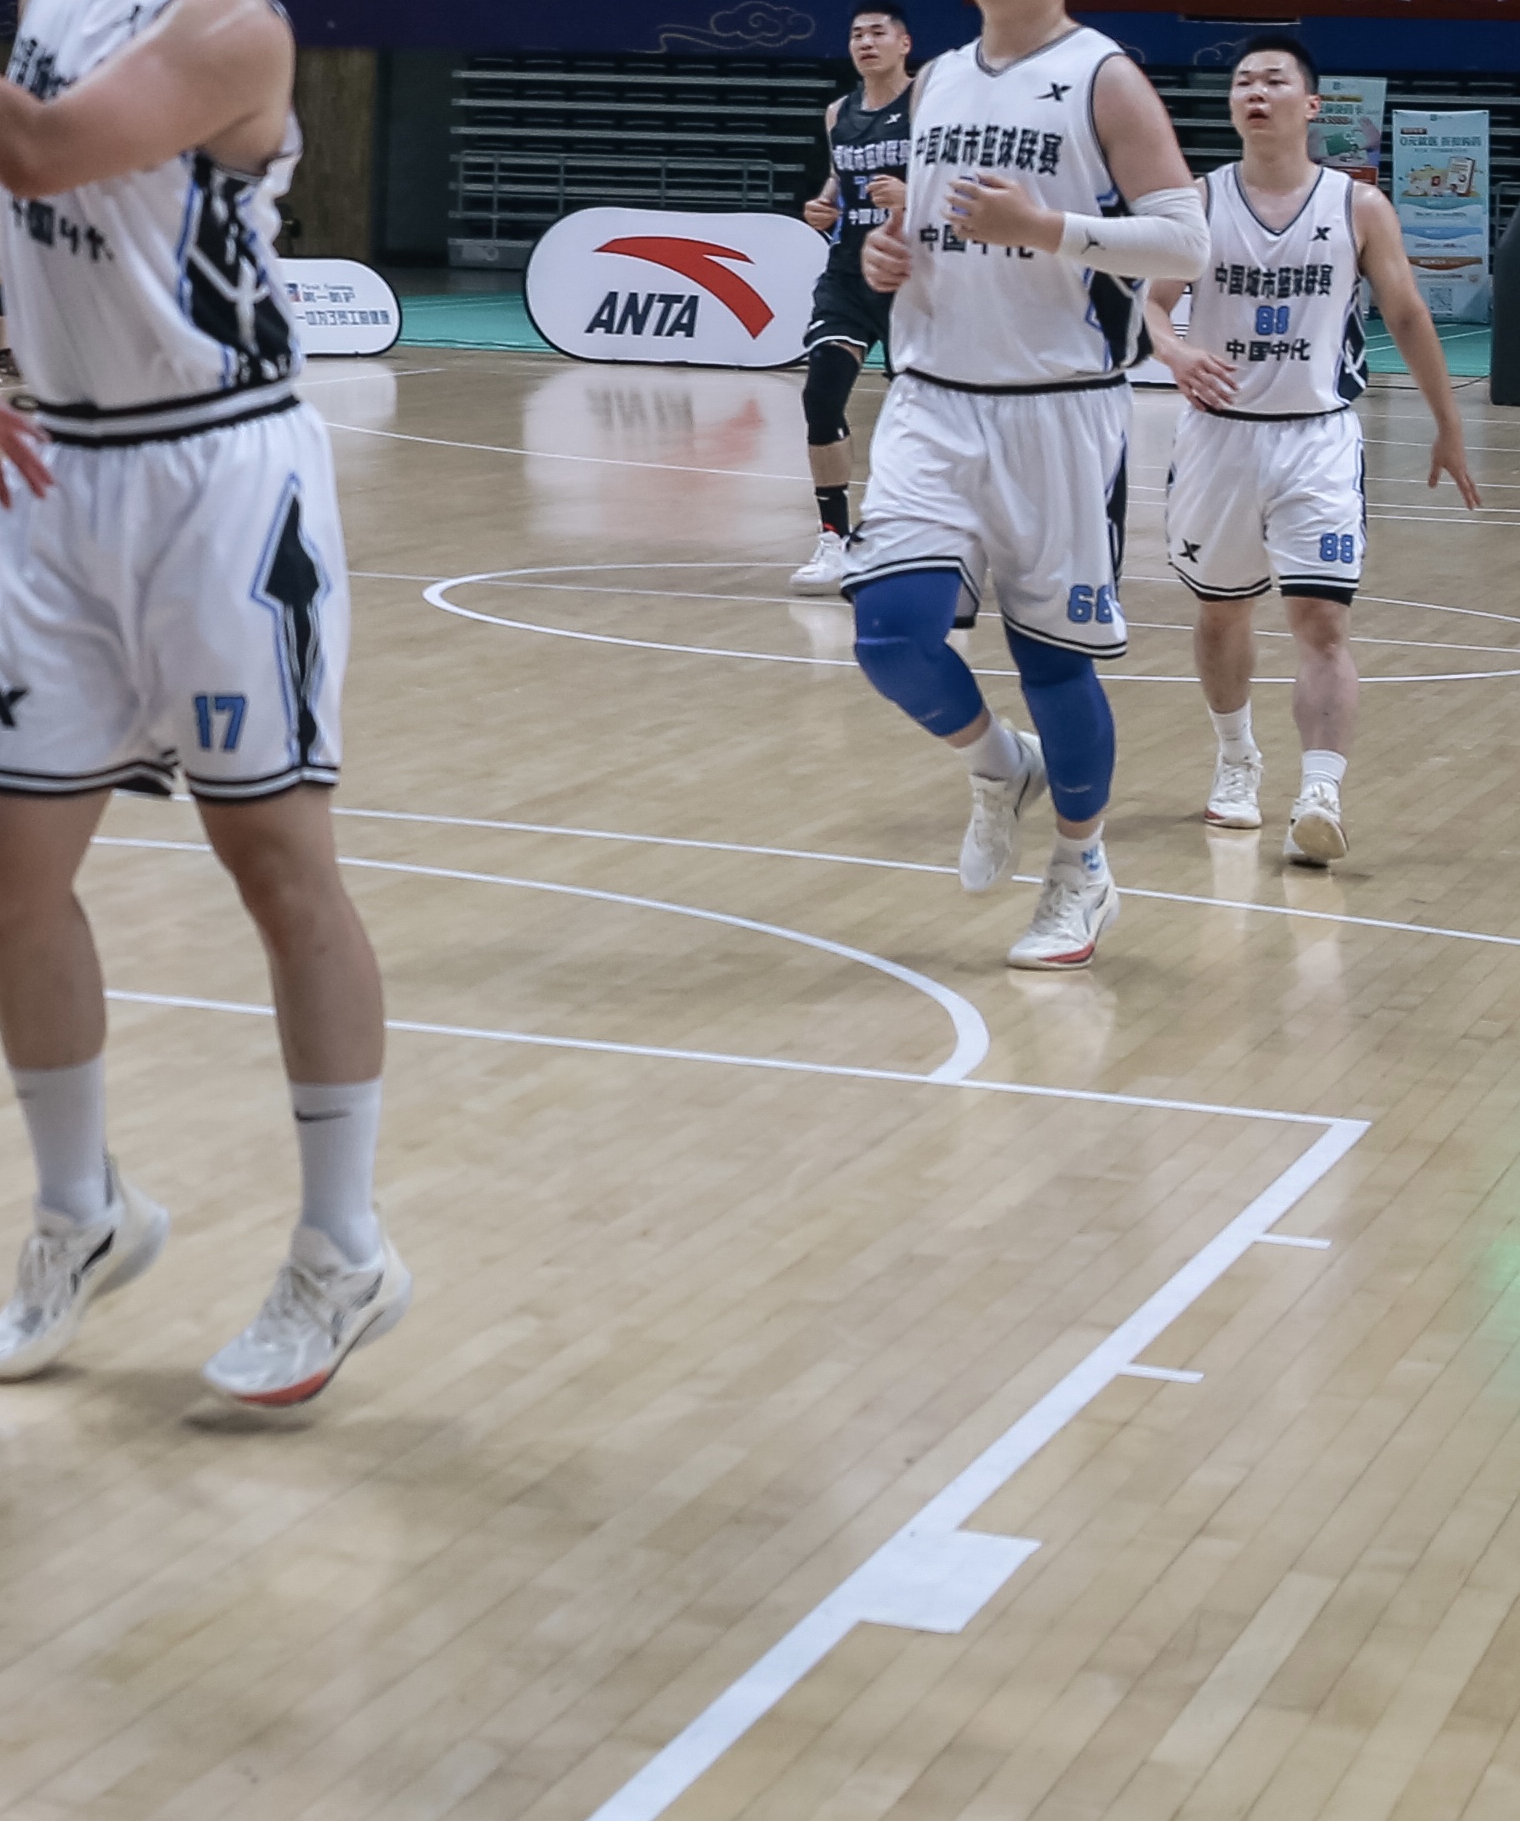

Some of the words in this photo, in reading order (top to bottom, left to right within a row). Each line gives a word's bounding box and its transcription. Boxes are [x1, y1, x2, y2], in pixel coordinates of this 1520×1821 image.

[916, 123, 1064, 176] 中国城市篮球联赛
[584, 291, 700, 338] ANTA
[1226, 339, 1311, 361] 中国中化
[1320, 533, 1353, 564] 88
[195, 694, 246, 750] 17
